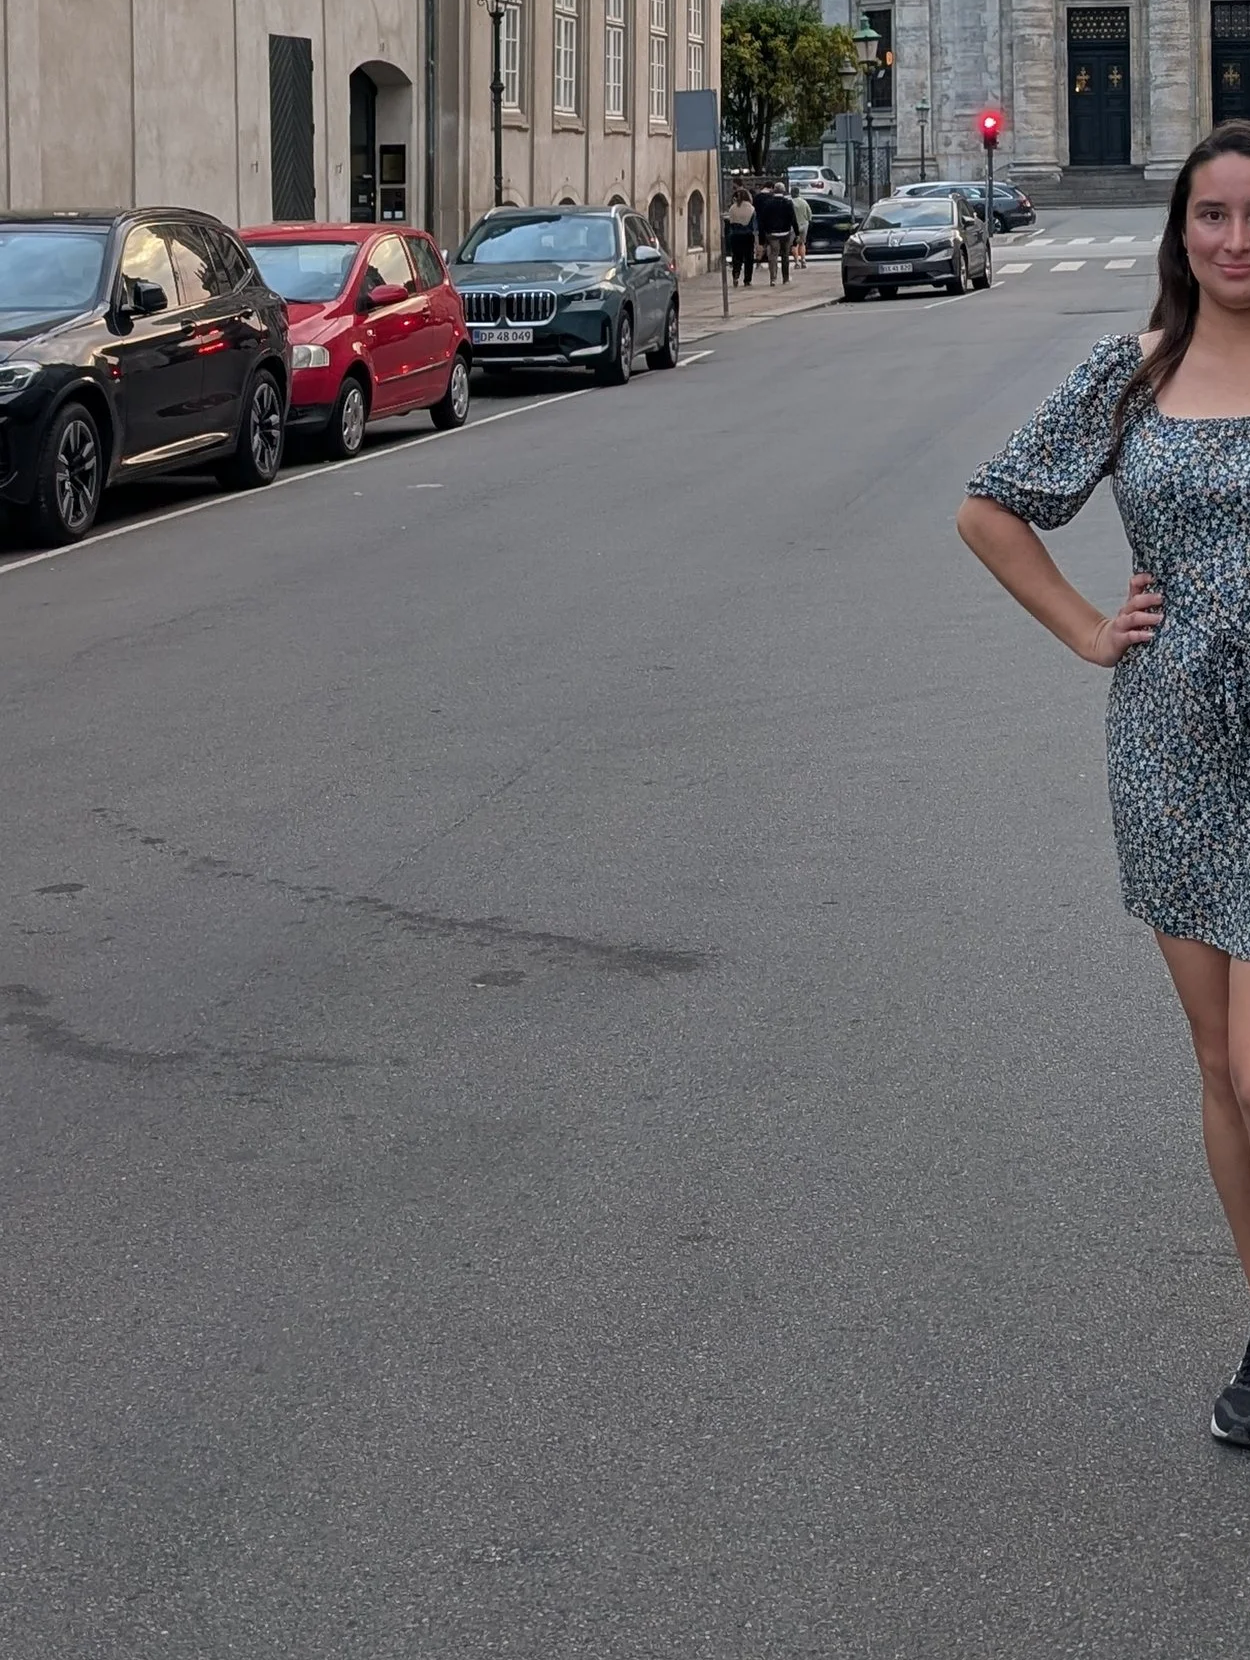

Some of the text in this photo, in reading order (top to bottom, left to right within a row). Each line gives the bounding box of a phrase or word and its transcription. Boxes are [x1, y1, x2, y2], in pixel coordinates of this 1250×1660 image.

[481, 331, 531, 341] DP 48 049
